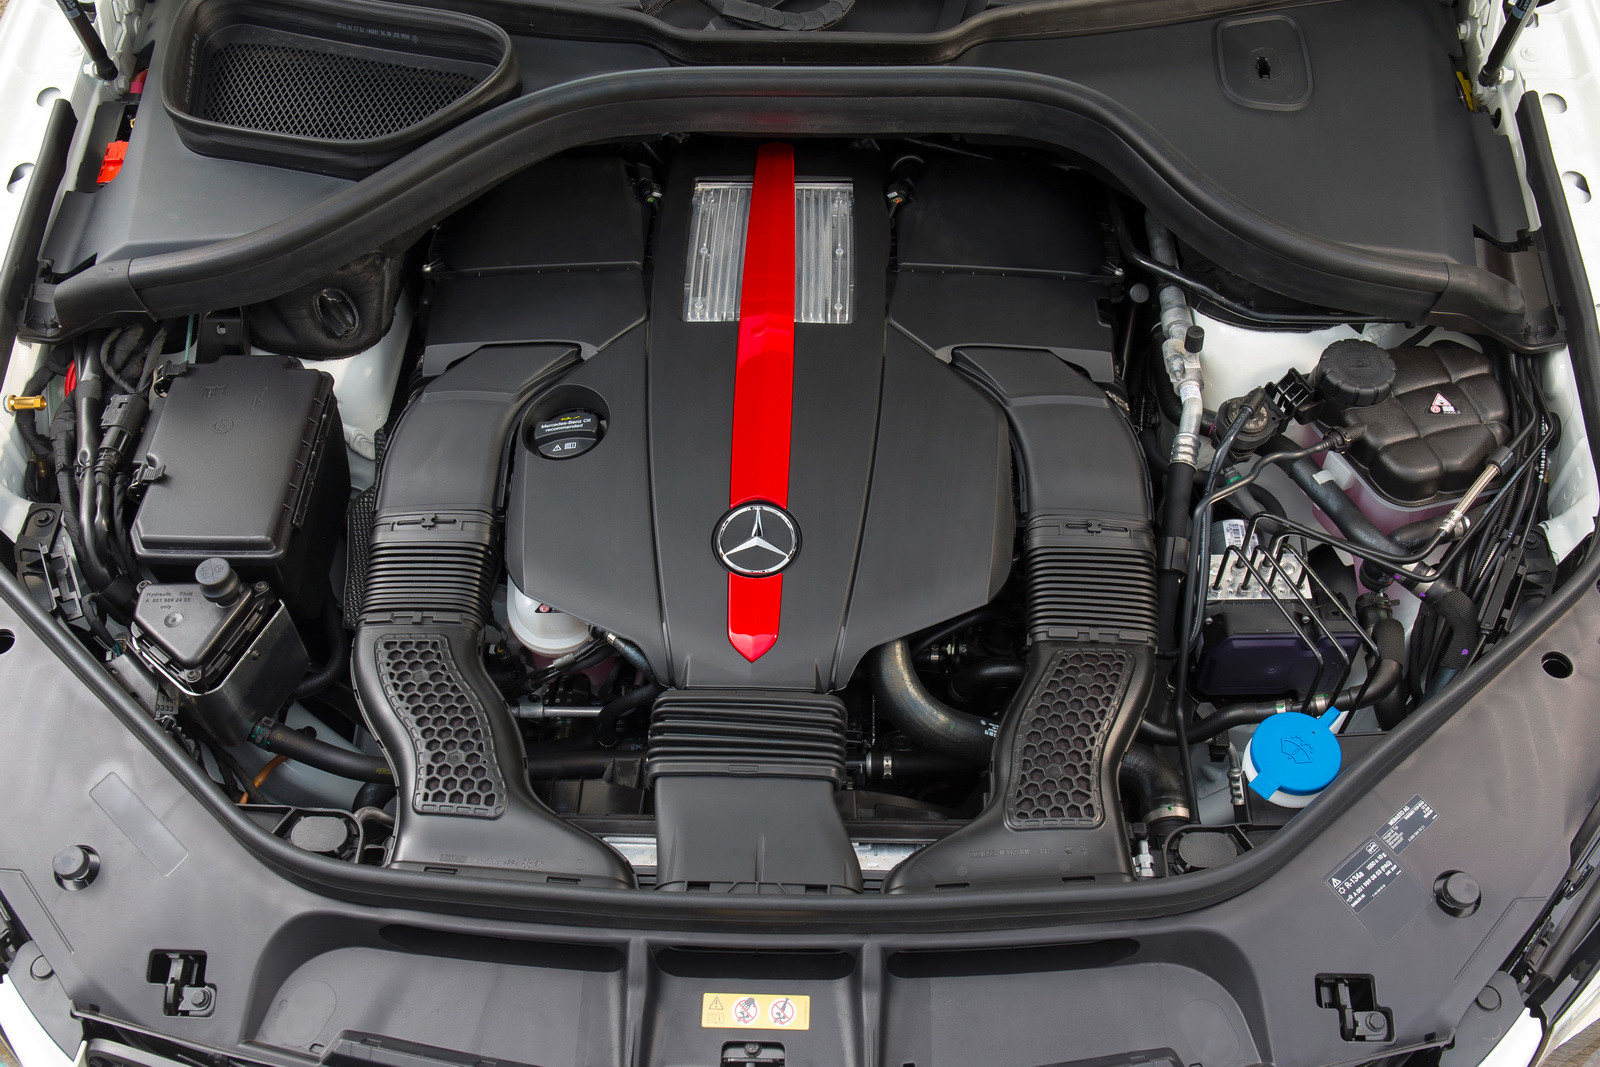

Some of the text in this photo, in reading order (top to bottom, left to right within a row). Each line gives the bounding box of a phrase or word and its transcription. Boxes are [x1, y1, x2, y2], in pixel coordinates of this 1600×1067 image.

[541, 419, 582, 429] Mercedes-Benz
[545, 423, 583, 432] recommended
[1344, 872, 1364, 889] R-134a
[1356, 886, 1365, 894] 001
[1380, 860, 1393, 872] (PAG)
